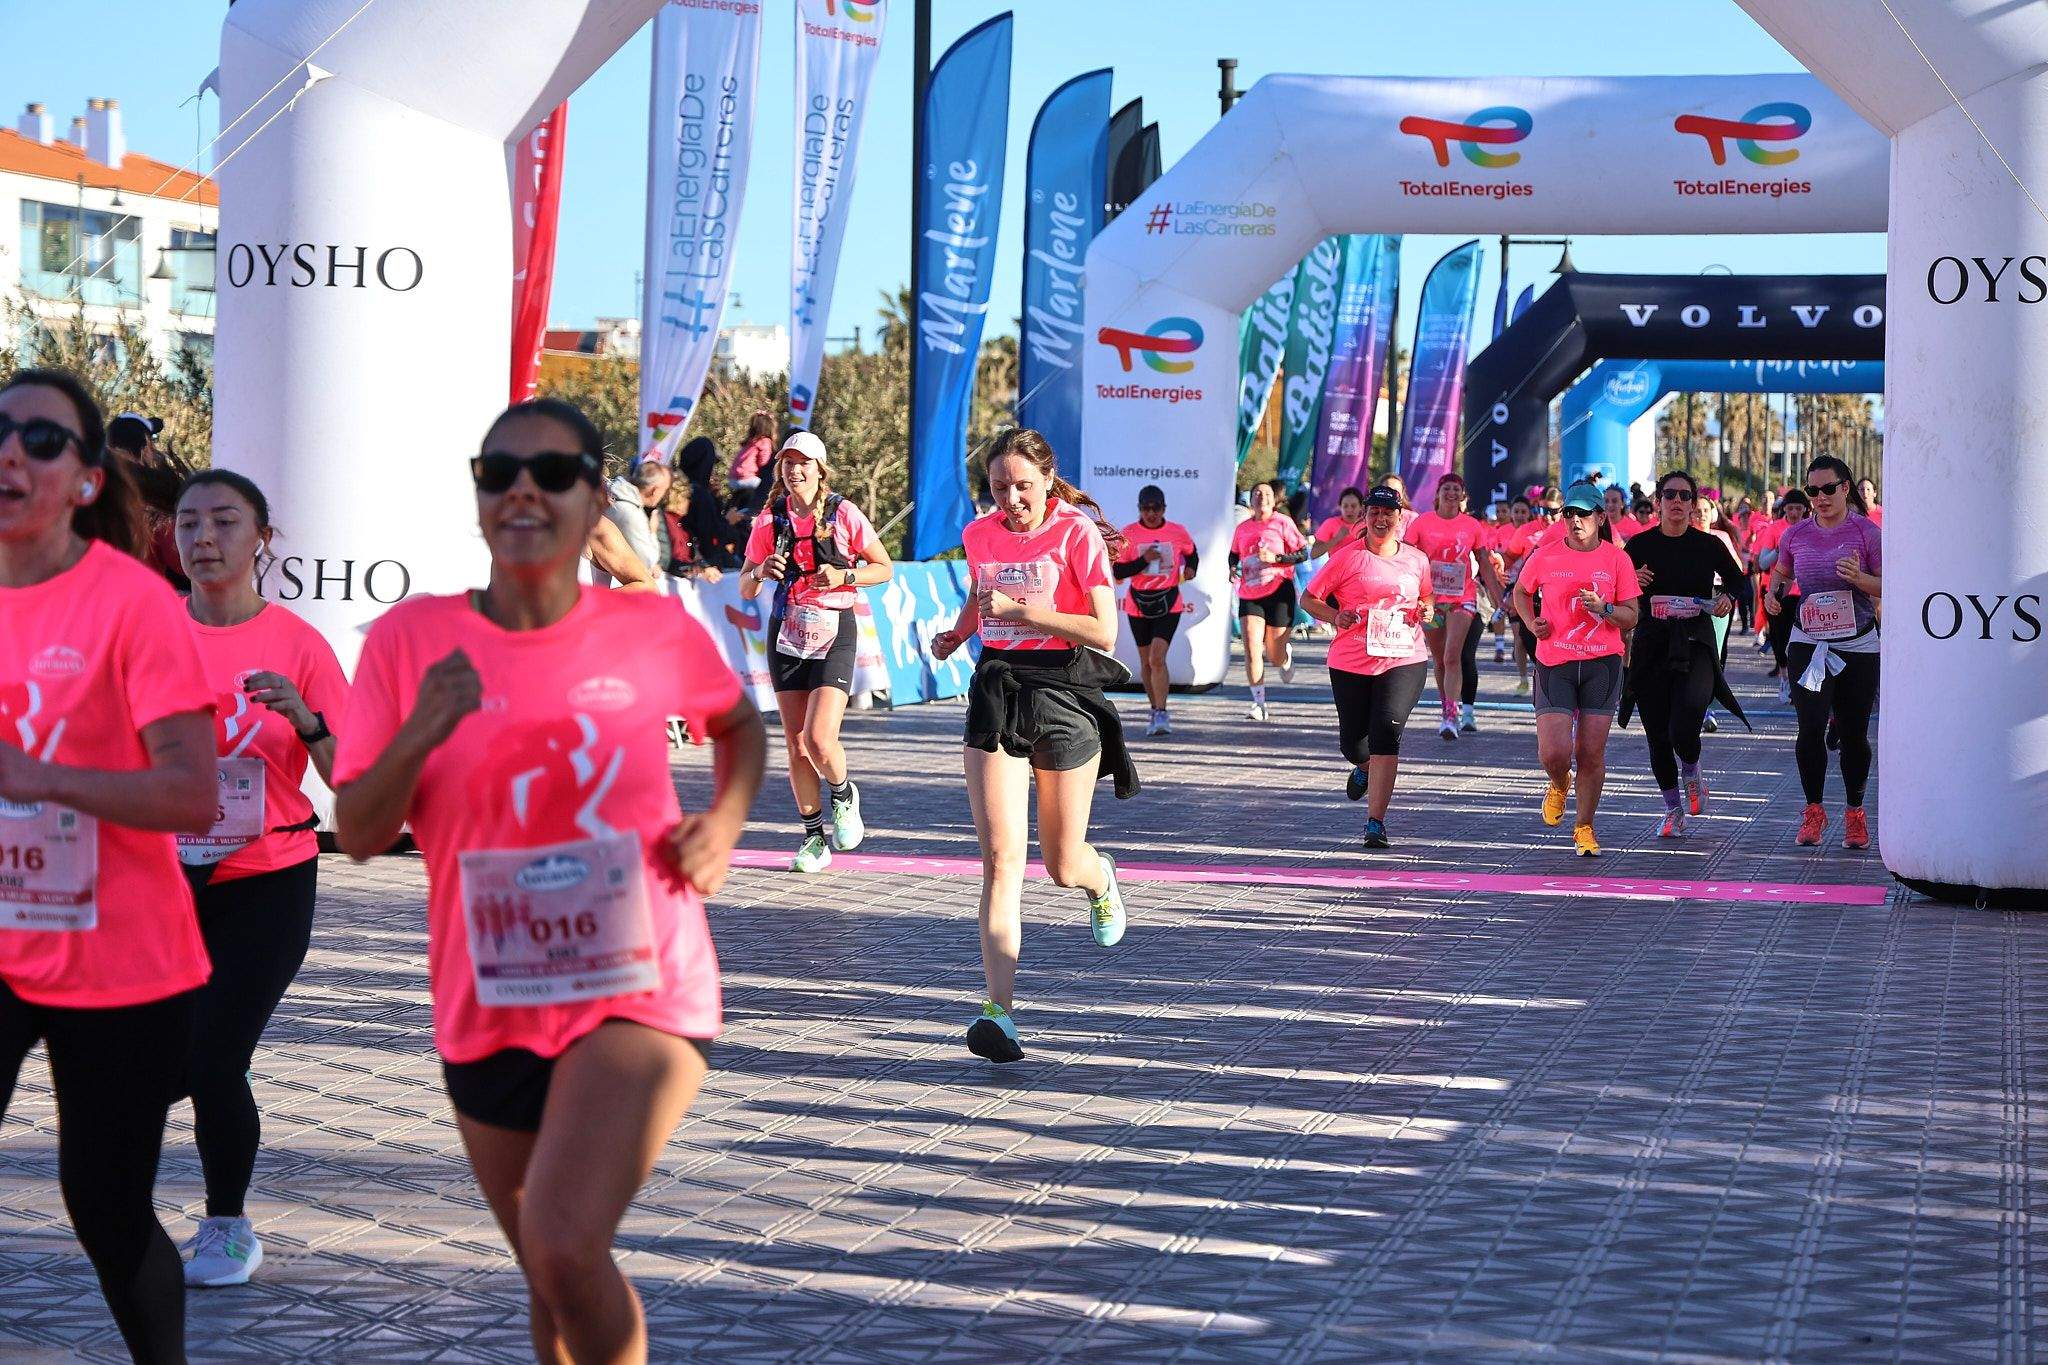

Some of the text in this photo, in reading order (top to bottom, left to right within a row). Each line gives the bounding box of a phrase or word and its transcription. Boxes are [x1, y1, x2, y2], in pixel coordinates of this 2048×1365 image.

[804, 22, 878, 47] TotalEnergies
[1399, 181, 1533, 200] TotalEnergies
[1674, 179, 1812, 198] TotalEnergies
[1174, 219, 1277, 236] LasCarreras
[920, 158, 989, 355] Marlene
[228, 243, 423, 291] OYSHO
[1027, 191, 1086, 369] Marlene
[1620, 303, 1884, 329] VOLVO
[1096, 384, 1203, 403] TotalEnergies
[1093, 465, 1200, 480] totalenergies.es
[253, 556, 411, 604] YSHO
[1819, 612, 1839, 622] 016
[798, 629, 819, 641] 016
[1385, 631, 1401, 639] 016
[195, 837, 215, 845] MUJER
[529, 911, 597, 945] 016
